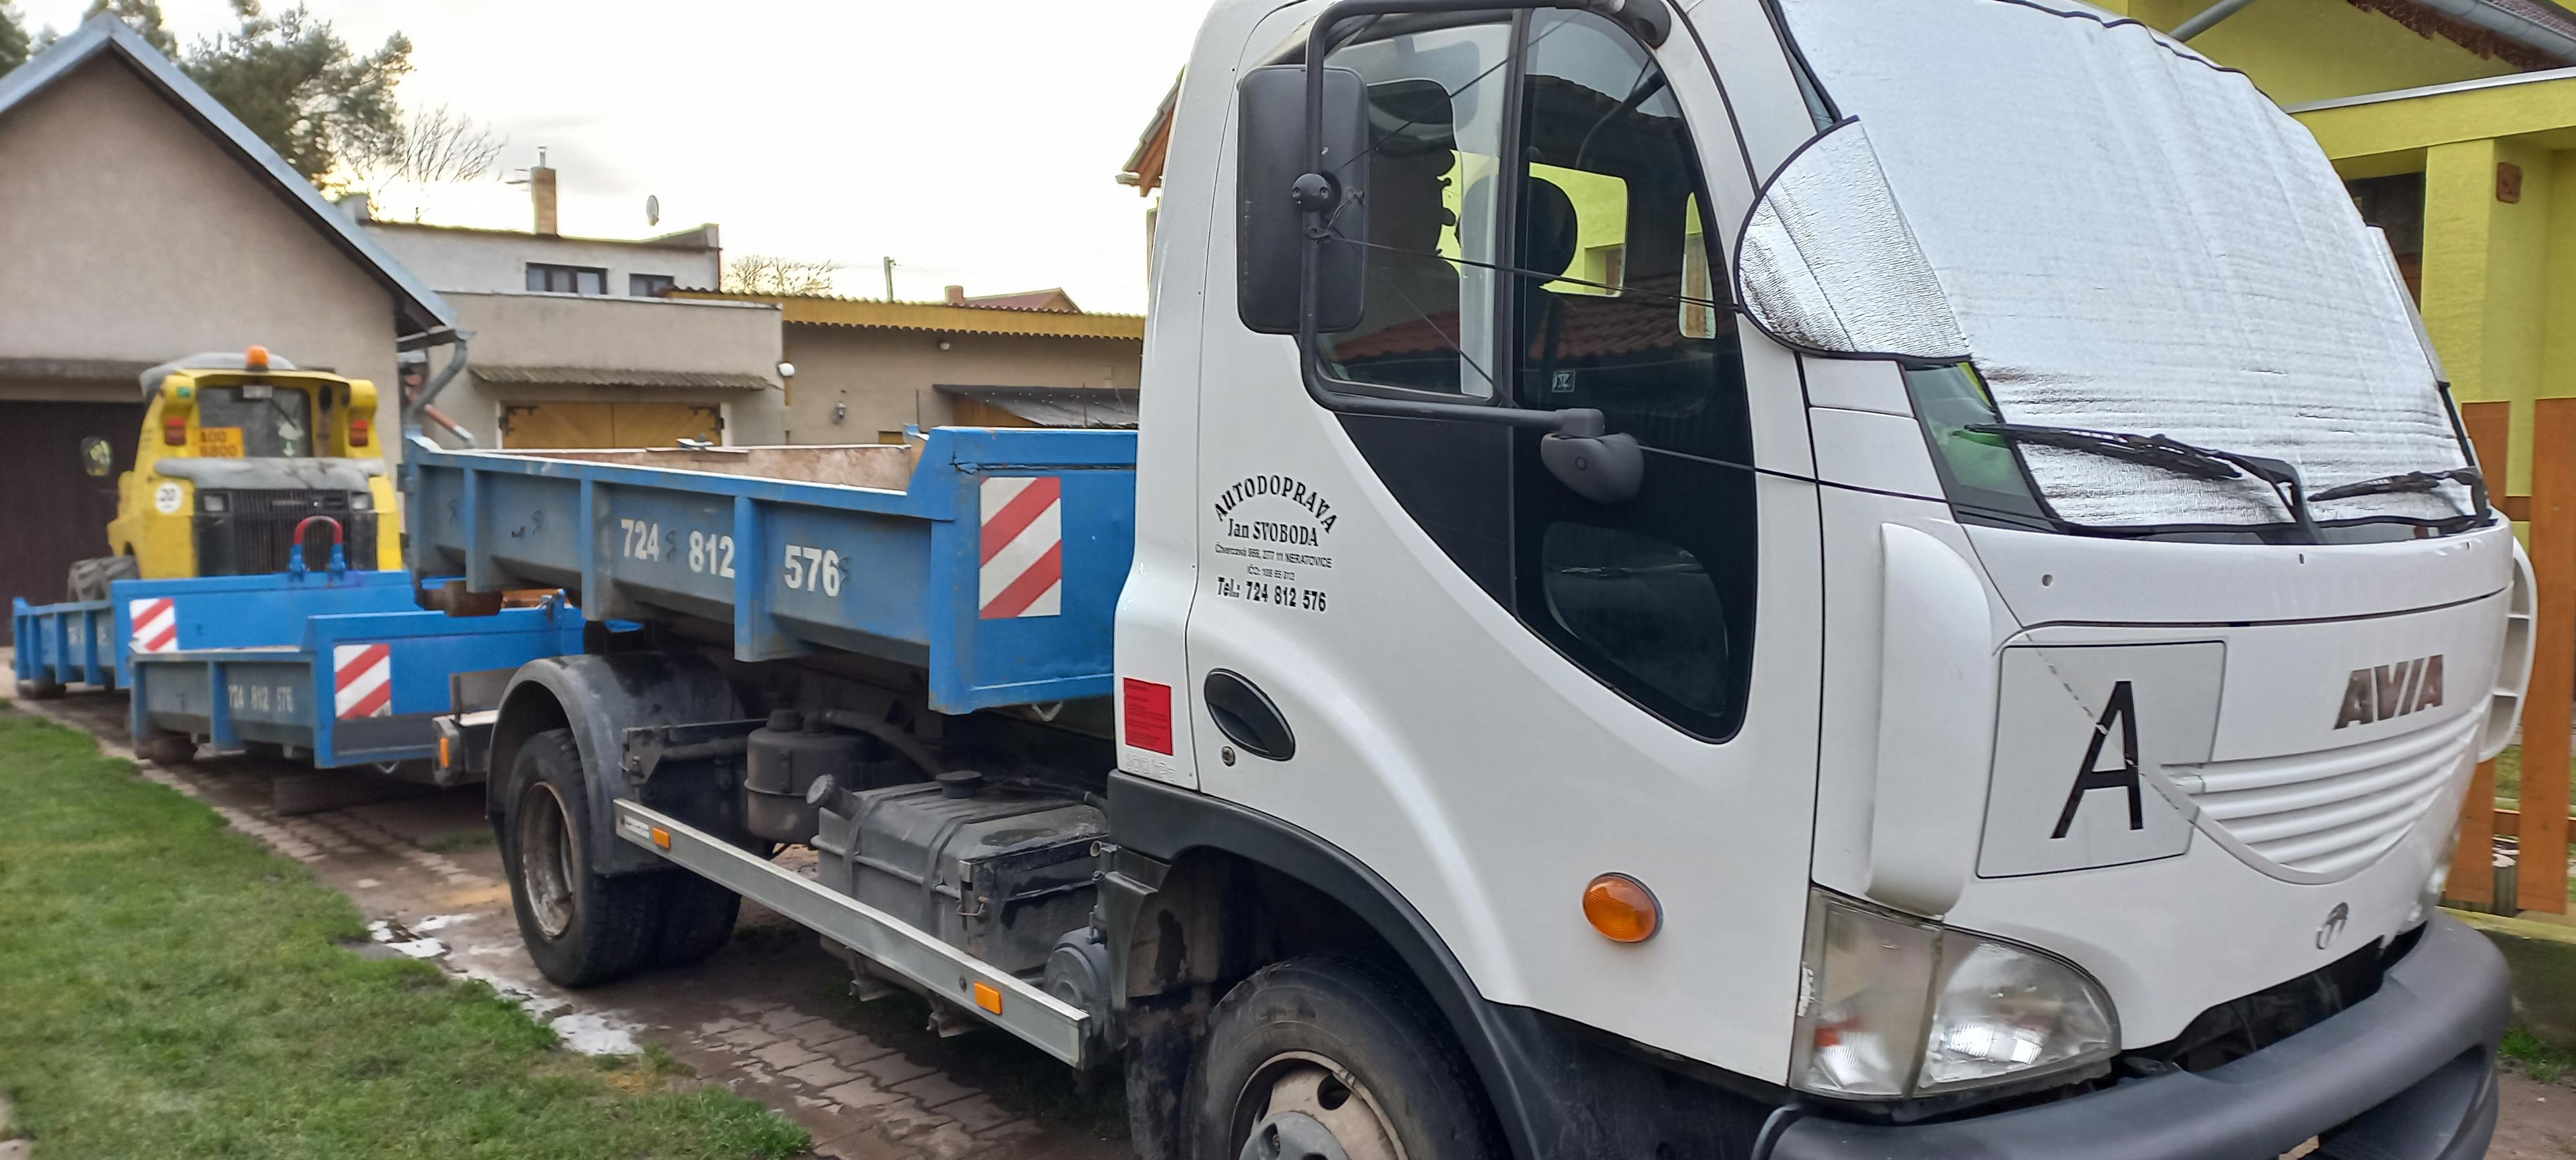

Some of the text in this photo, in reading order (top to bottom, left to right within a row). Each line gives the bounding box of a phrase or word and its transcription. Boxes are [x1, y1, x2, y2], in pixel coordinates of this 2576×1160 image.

[1214, 475, 1337, 534] AUTODOPRAVA
[1228, 518, 1318, 547] Jan SVOBODA
[621, 518, 840, 597] 724 812 576
[1246, 581, 1269, 603] 724
[1274, 585, 1297, 608] 812
[1302, 589, 1327, 612] 576
[2333, 654, 2443, 729] AVIA
[2050, 680, 2144, 839] A
